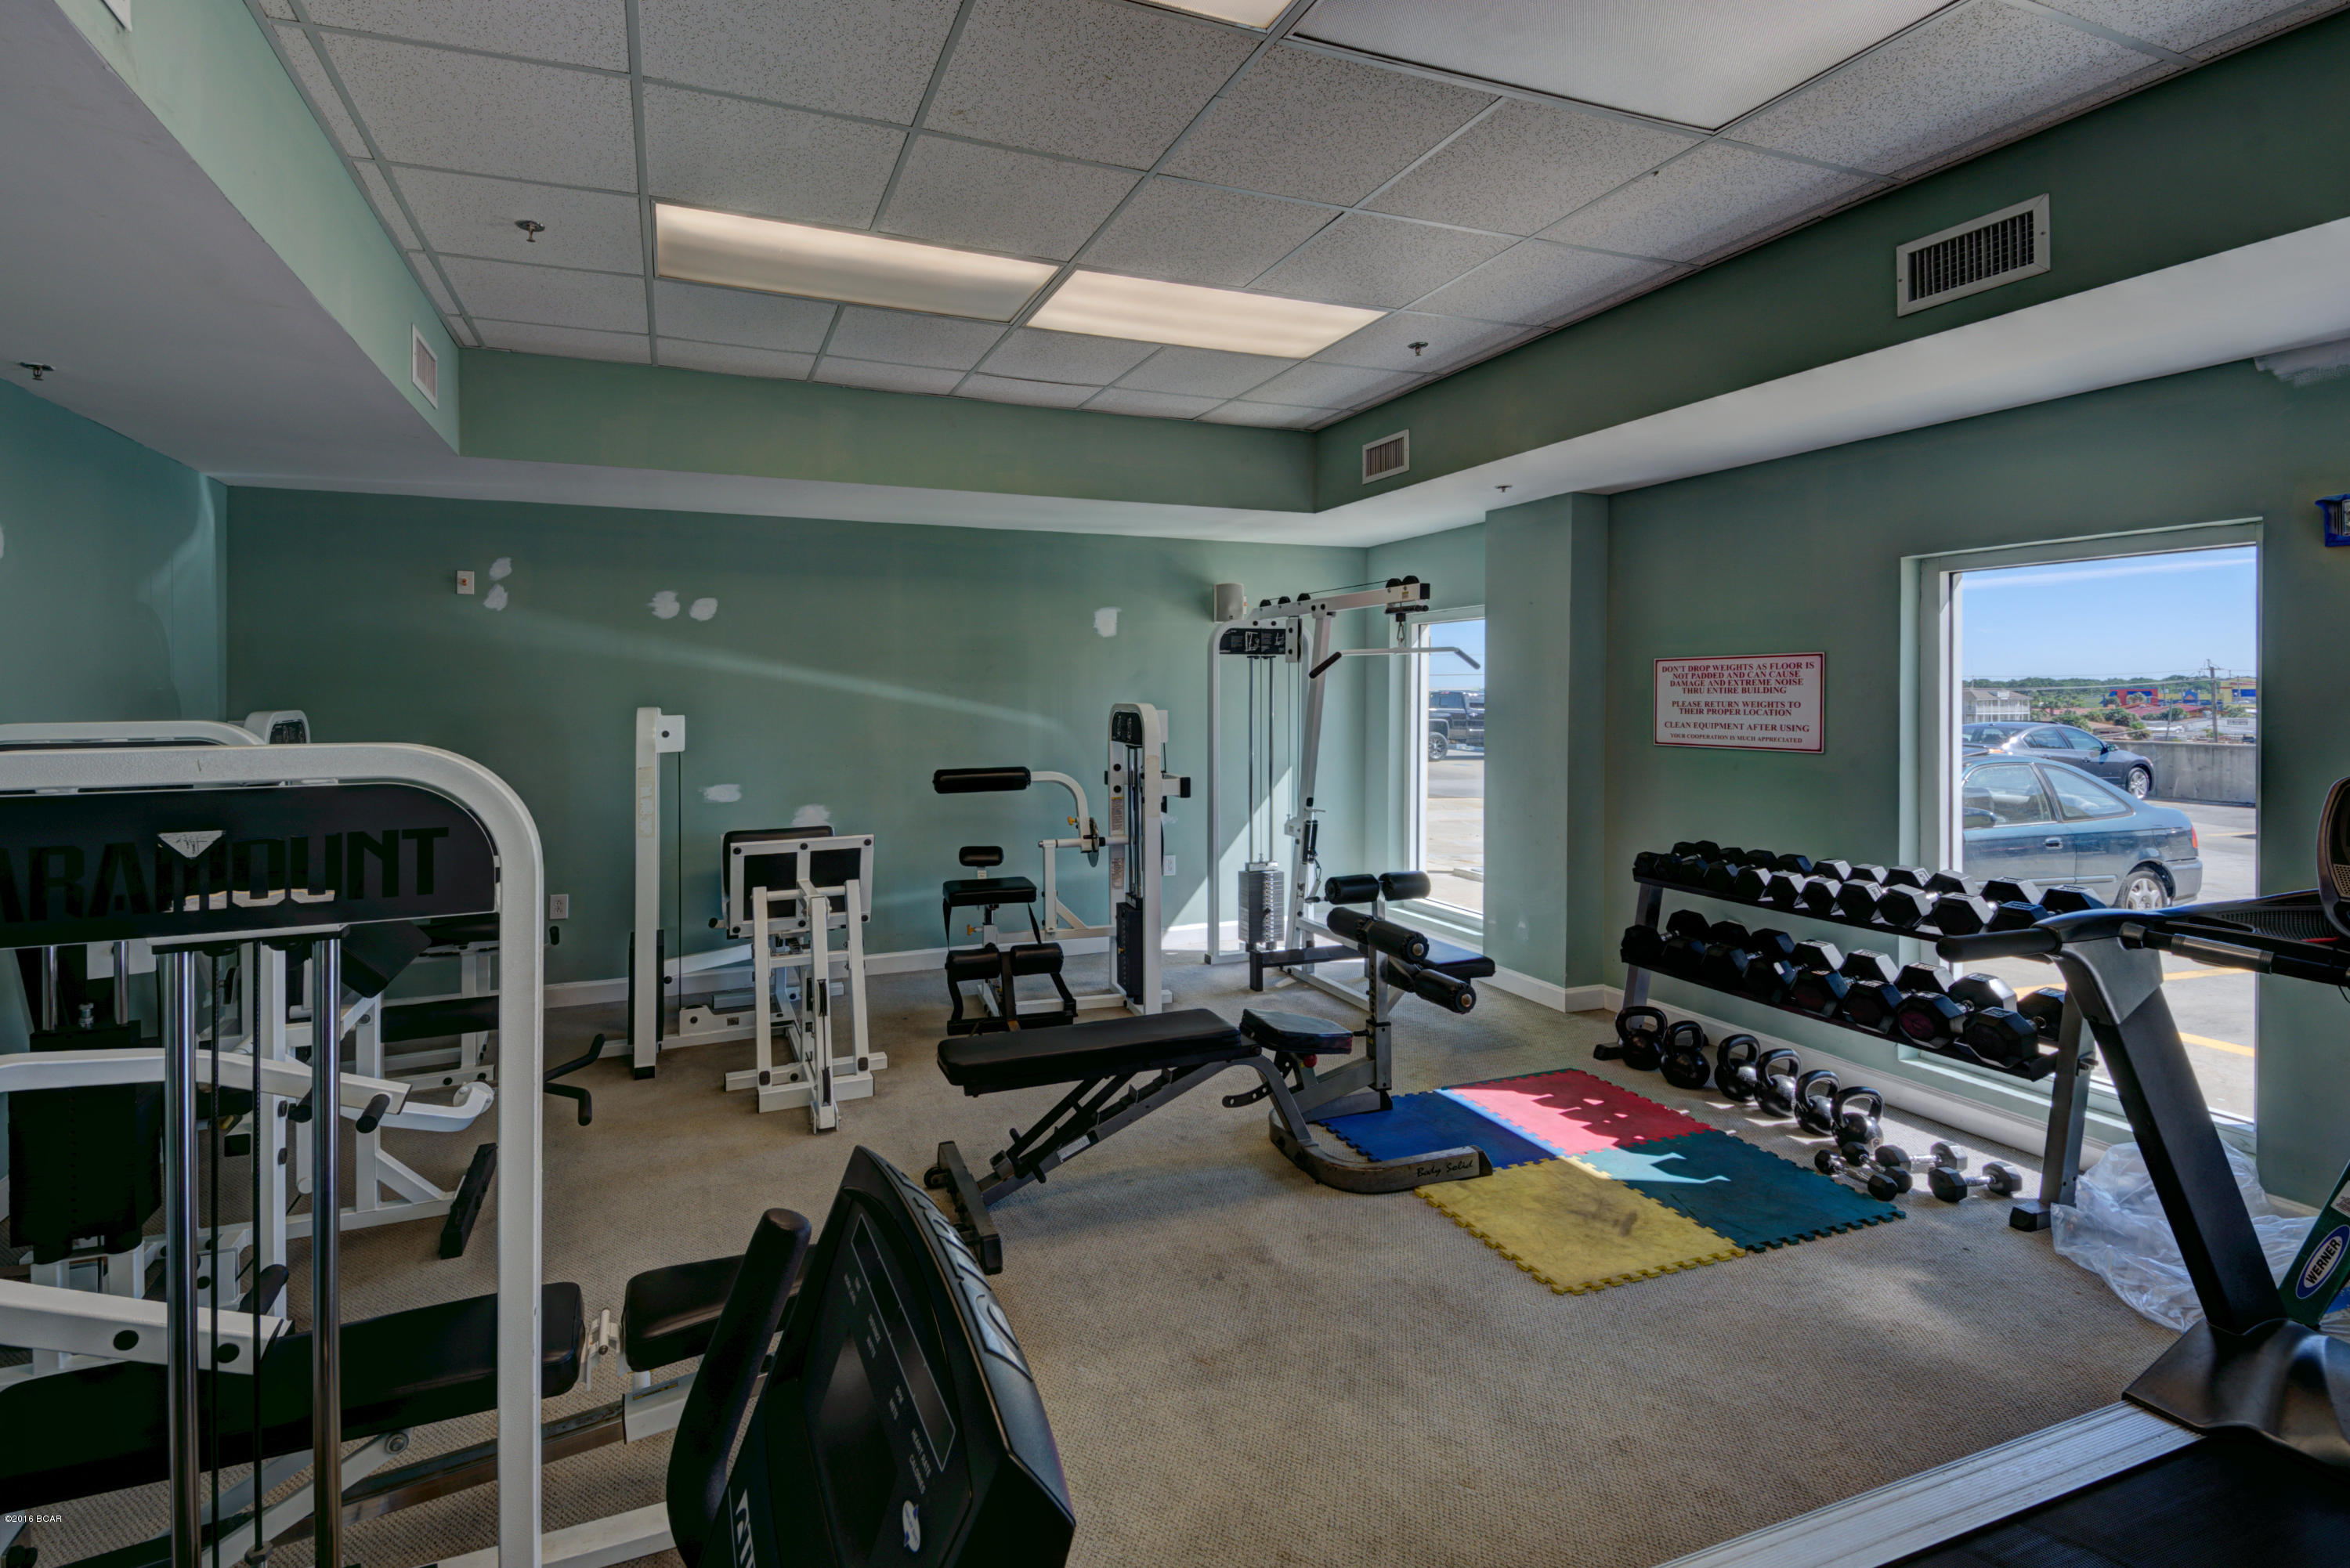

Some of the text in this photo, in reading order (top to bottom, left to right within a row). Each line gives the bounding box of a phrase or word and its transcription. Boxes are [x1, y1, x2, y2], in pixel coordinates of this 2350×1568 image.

[1806, 661, 1815, 670] IS
[1769, 670, 1801, 678] CAUSE
[1743, 708, 1792, 717] LOCATION
[1693, 721, 1745, 730] EQUIPMENT
[1747, 723, 1778, 732] AFTER
[1780, 724, 1810, 733] USING
[1446, 1159, 1473, 1172] Solid
[2305, 1238, 2341, 1284] WERNER
